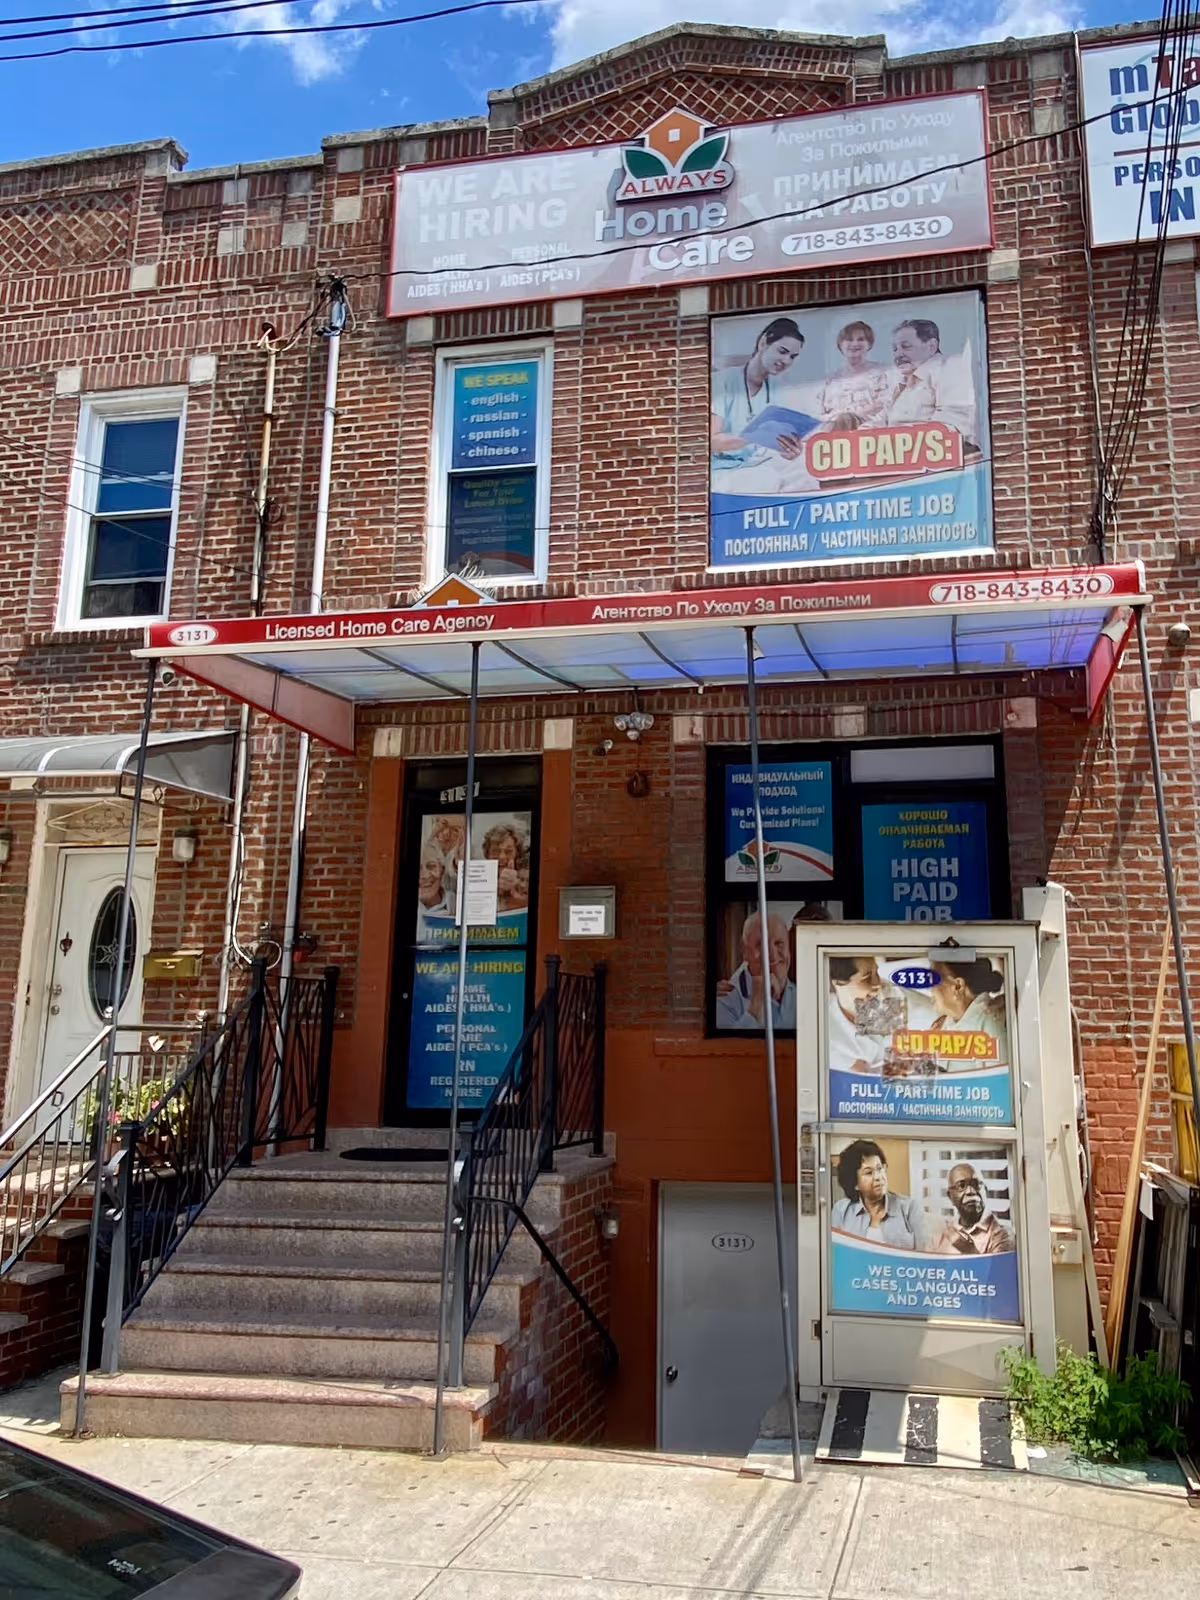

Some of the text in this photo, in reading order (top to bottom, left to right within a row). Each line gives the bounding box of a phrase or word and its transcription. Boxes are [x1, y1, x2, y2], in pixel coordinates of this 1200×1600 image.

[776, 121, 866, 146] Агентство
[871, 113, 897, 135] По
[801, 133, 929, 162] За Пожилыми
[415, 158, 577, 208] WE ARE
[623, 169, 726, 197] ALWAYS
[773, 153, 960, 196] ПРИНИМАЕМ
[784, 181, 948, 222] НА РАБОТУ
[418, 198, 568, 244] HIRING
[594, 200, 729, 242] Home
[790, 219, 942, 251] 718-843-8430
[433, 253, 467, 268] HOME
[648, 233, 755, 271] Care
[500, 271, 533, 288] AIDES
[407, 284, 441, 299] AIDES
[463, 371, 529, 389] WE SPEAK
[471, 391, 519, 408] english
[470, 410, 519, 424] russian
[468, 426, 520, 443] spanish
[468, 444, 519, 458] chinese
[812, 429, 953, 471] CD PAP/S:
[743, 506, 790, 530] FULL
[810, 500, 862, 524] PART
[864, 497, 912, 520] TIME
[917, 493, 955, 517] JOB
[724, 532, 808, 556] ПОСТОЯННАЯ
[820, 526, 897, 549] ЧАСТИЧНАЯ
[901, 522, 978, 545] ЗАНЯТОСТЬ
[940, 577, 1103, 601] 718-843-8430
[591, 590, 873, 621] Агентство По Уходу За Пожилыми
[176, 629, 211, 643] 3131
[264, 611, 496, 642] Licensed Home Care Agency
[731, 807, 745, 817] We
[898, 809, 948, 821] ХОРОШО
[902, 838, 946, 849] РАБОТА
[890, 857, 960, 878] HIGH
[893, 881, 959, 902] PAID
[415, 962, 438, 974] WE
[473, 961, 524, 973] HIRING
[897, 971, 935, 985] 3131
[897, 1034, 994, 1056] CD PAP/S:
[851, 1083, 883, 1098] FULL
[966, 1087, 991, 1101] JOB
[838, 1102, 895, 1114] ПОСТОЯННАЯ
[902, 1103, 953, 1116] ЧАСТИЧНАЯ
[954, 1104, 1004, 1118] ЗАНЯТОСТЬ
[719, 1237, 747, 1248] 3131
[868, 1264, 979, 1282] WE COVER ALL
[851, 1277, 997, 1297] CASES, LANGUAGES
[887, 1293, 962, 1309] AND AGES
